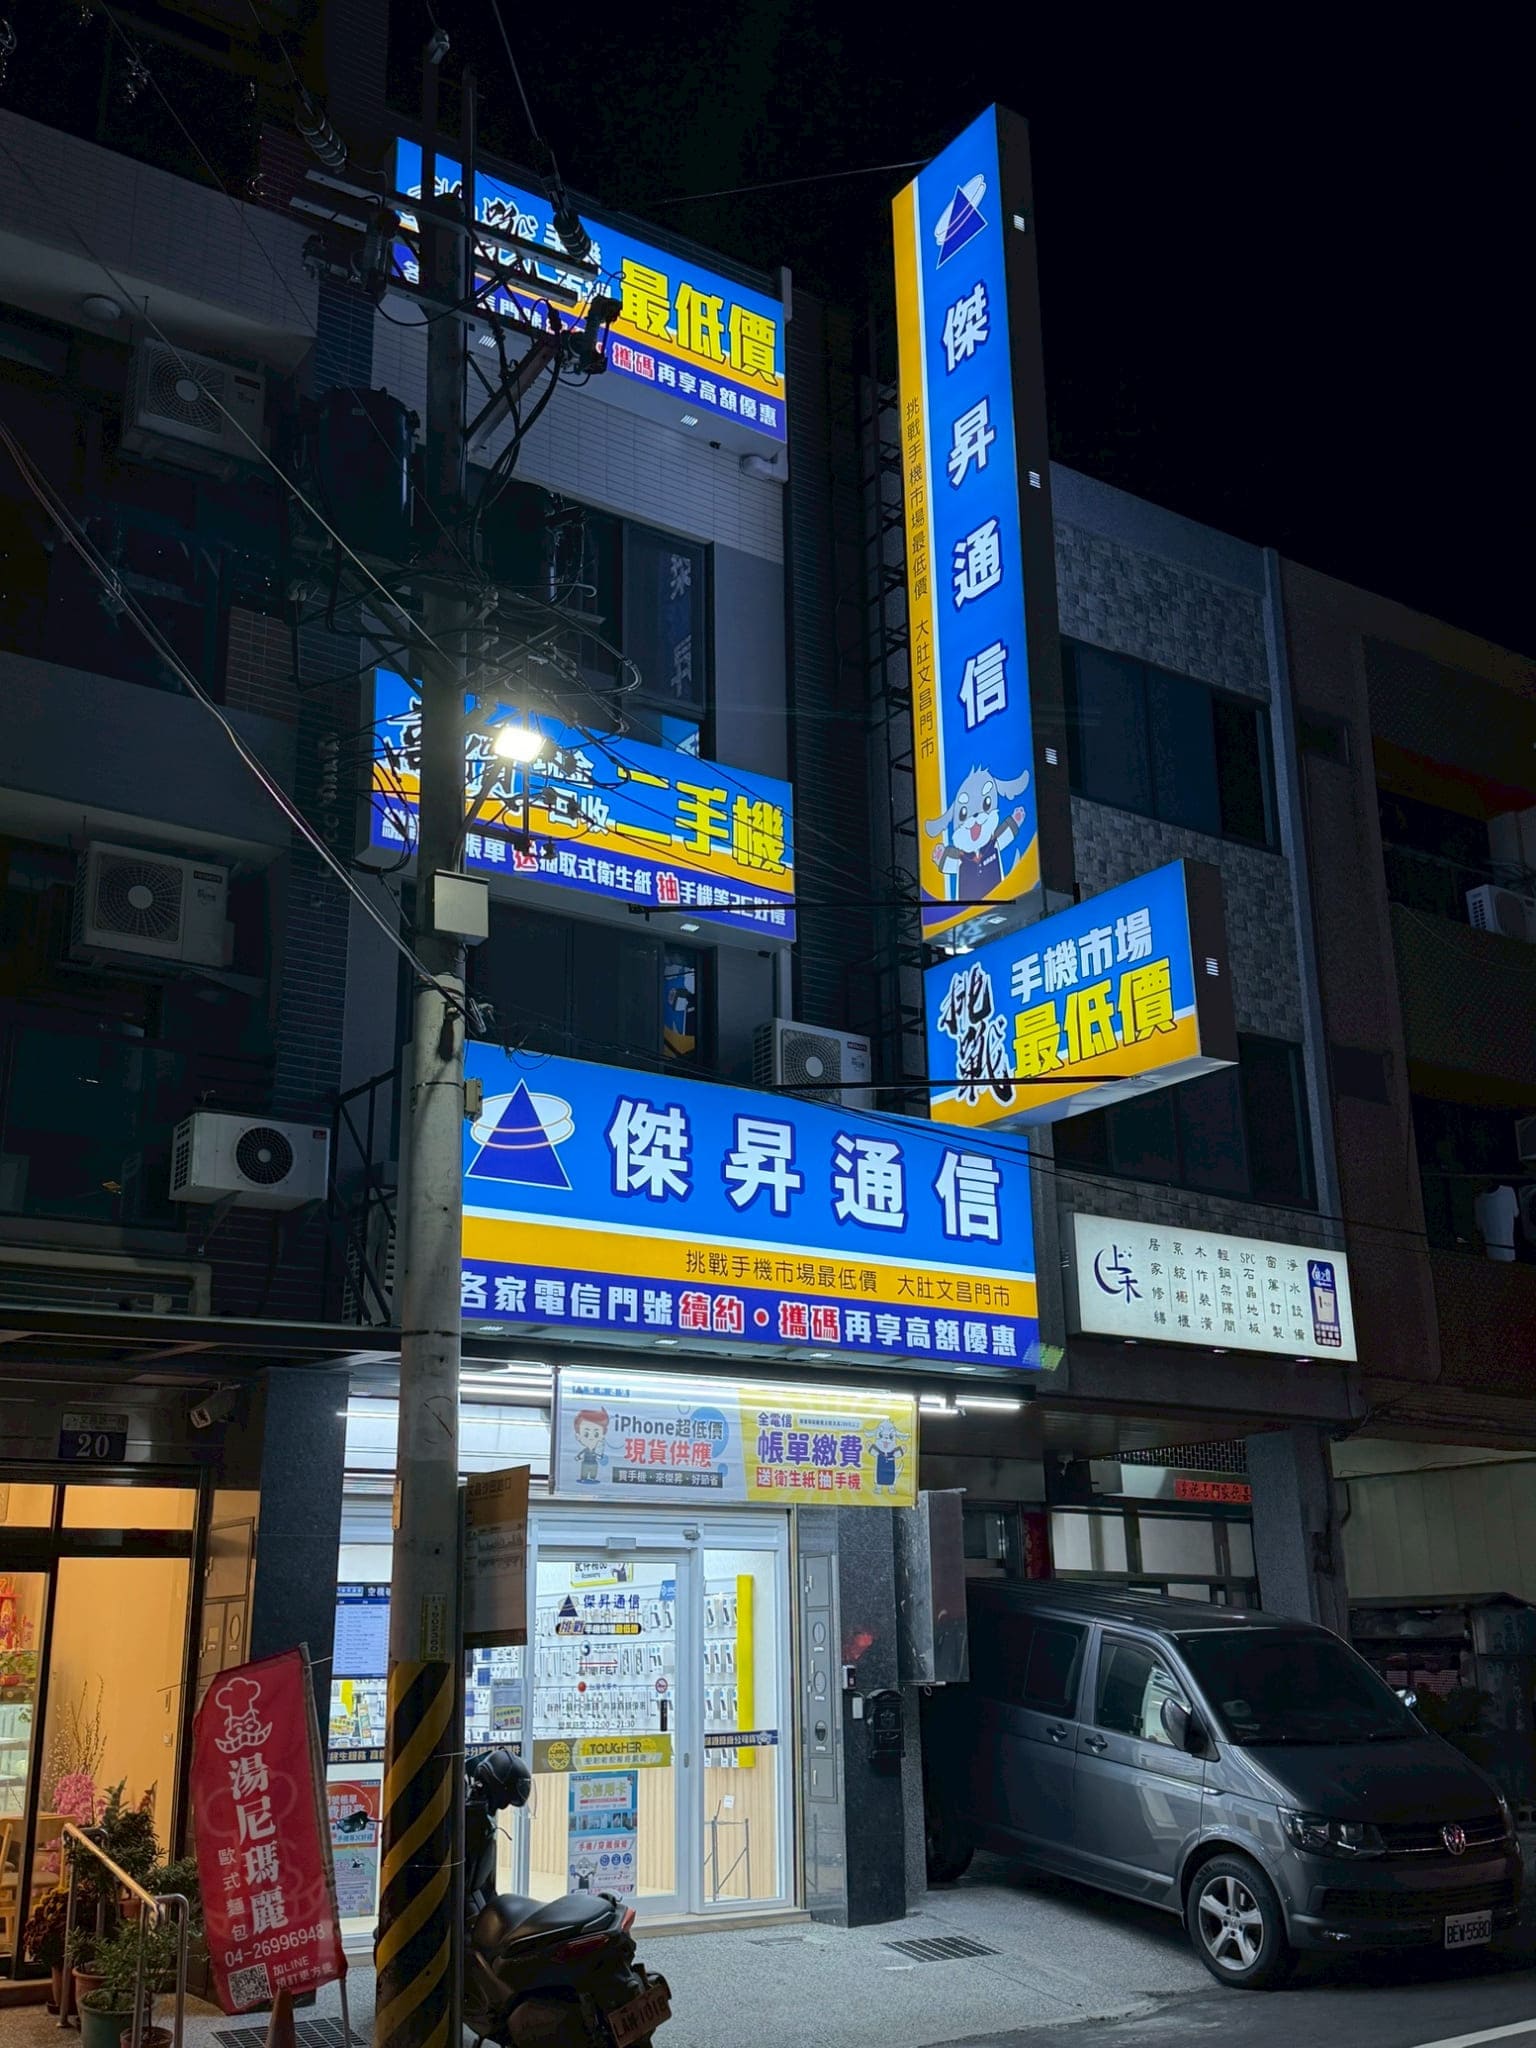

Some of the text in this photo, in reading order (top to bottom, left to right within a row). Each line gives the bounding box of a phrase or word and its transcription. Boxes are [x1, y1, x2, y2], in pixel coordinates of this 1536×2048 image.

[620, 256, 779, 386] 最低價
[942, 284, 1007, 729] 傑昇通信
[905, 397, 935, 760] 挑戰手機市場最低價 大肚文昌門市
[616, 764, 787, 874] 二手機
[1011, 907, 1152, 1004] 手機市場
[1012, 958, 1178, 1080] 最低價
[609, 1101, 1000, 1240] 傑昇通信
[686, 1249, 1011, 1308] 挑戰手機市場最低價 大肚文昌門市
[76, 1433, 110, 1458] 20
[614, 1413, 723, 1440] iPhone超低價
[757, 1411, 793, 1428] 全電信
[757, 1430, 863, 1468] 帳單繳費
[624, 1438, 712, 1467] 現貨供應
[583, 1593, 640, 1610] 傑昇通信
[589, 1741, 642, 1754] TOUGHER
[228, 1753, 290, 1937] 湯尼瑪麗
[225, 1923, 325, 1968] 04-26996948
